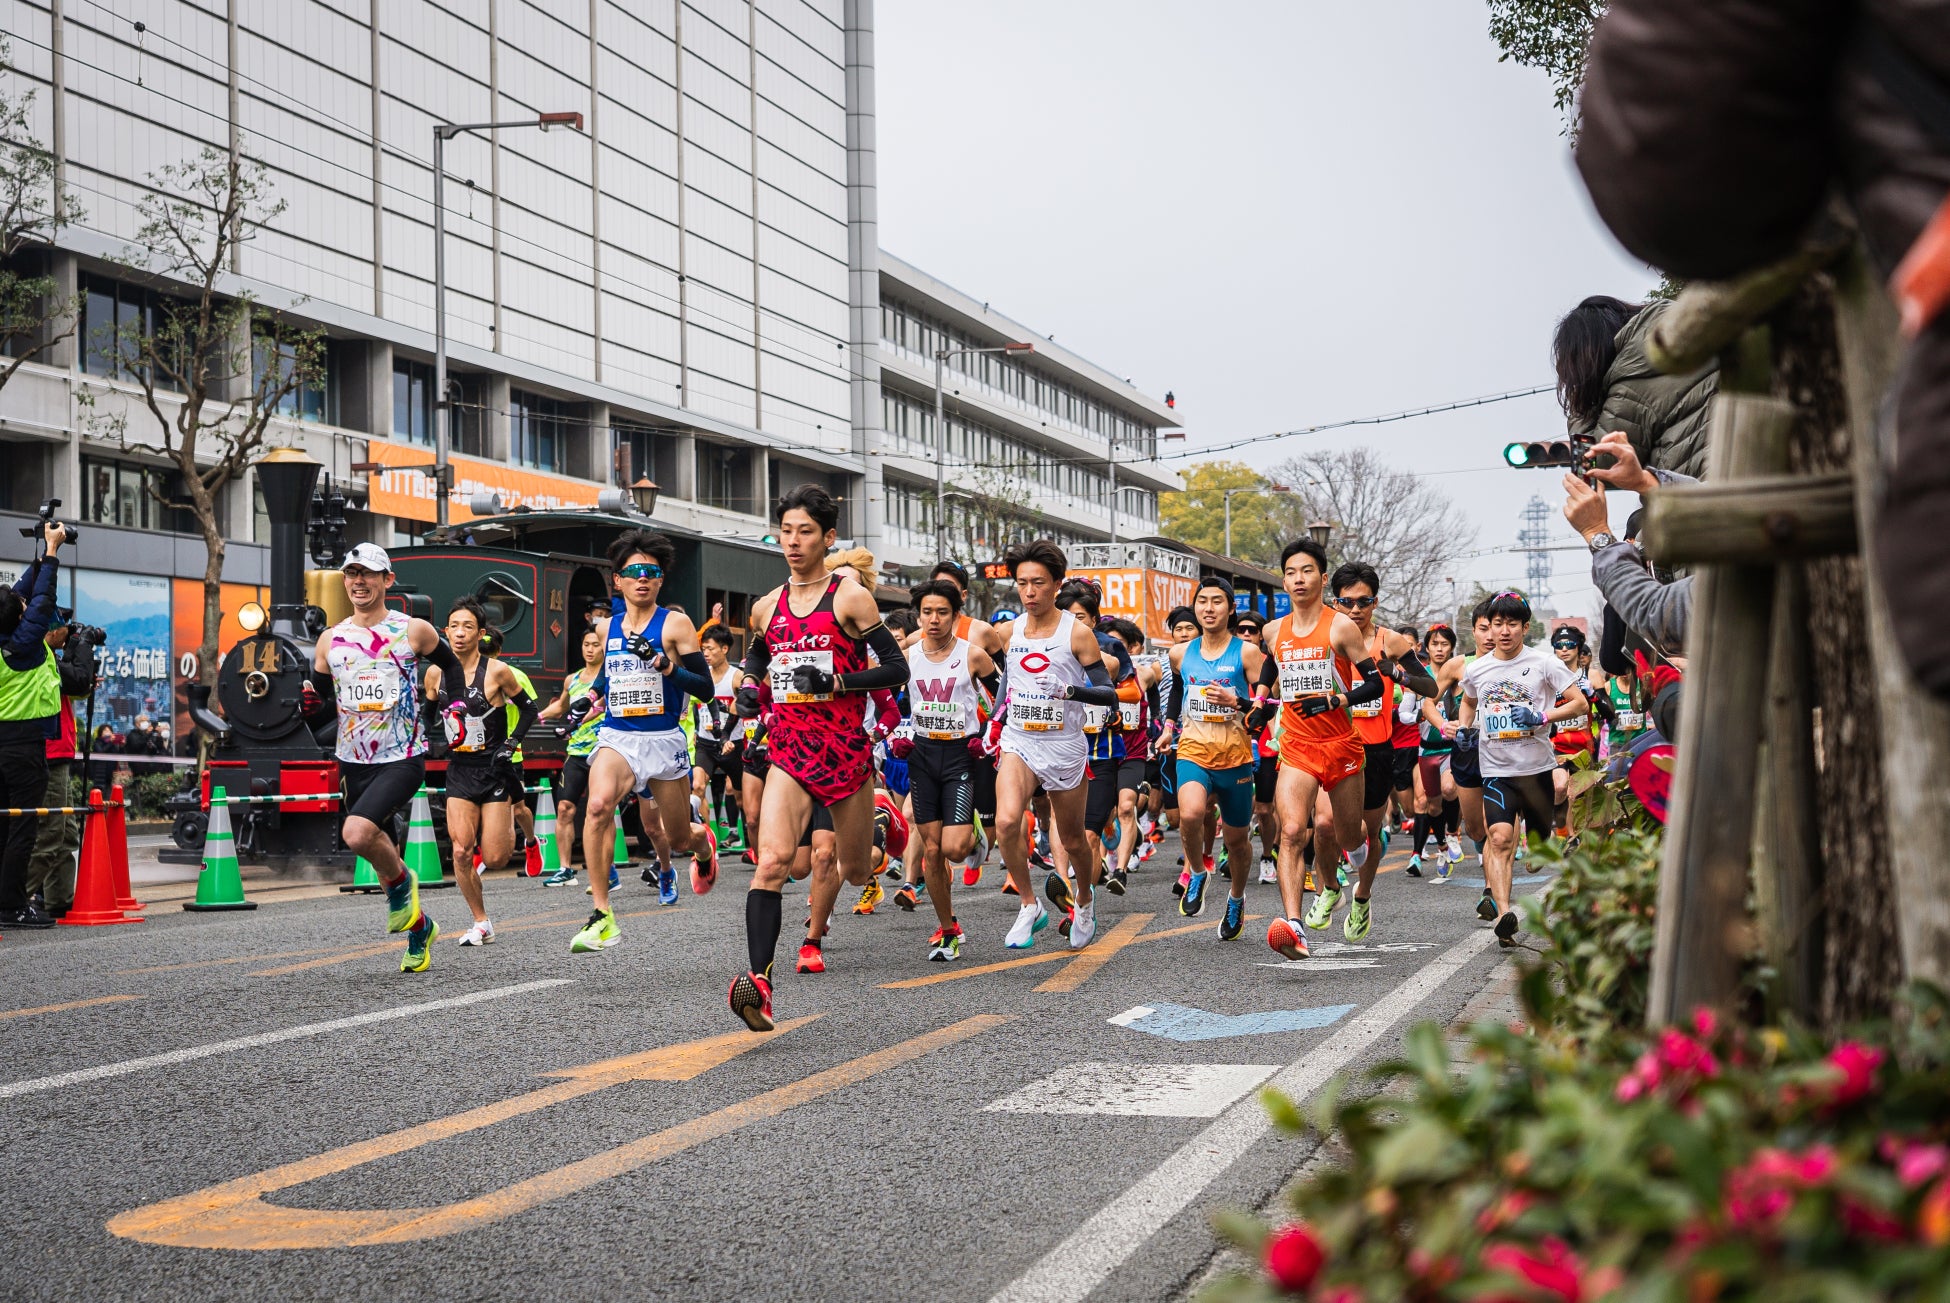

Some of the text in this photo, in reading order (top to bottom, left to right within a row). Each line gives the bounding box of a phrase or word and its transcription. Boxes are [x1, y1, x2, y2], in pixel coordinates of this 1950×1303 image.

[1153, 574, 1192, 612] START
[770, 634, 834, 652] コモディイイダ
[240, 640, 280, 672] 14
[794, 655, 817, 664] ヤマキ
[1281, 646, 1323, 661] 愛媛銀行
[181, 652, 197, 679] の
[1217, 665, 1235, 673] HOKA
[347, 683, 399, 701] 1046 S
[915, 676, 957, 703] W
[1282, 675, 1332, 692] 中村佳樹 S
[609, 689, 663, 707] 巻田理空 S
[931, 703, 957, 713] FUJI
[1055, 711, 1063, 722] S
[957, 720, 965, 730] S
[476, 731, 484, 743] S
